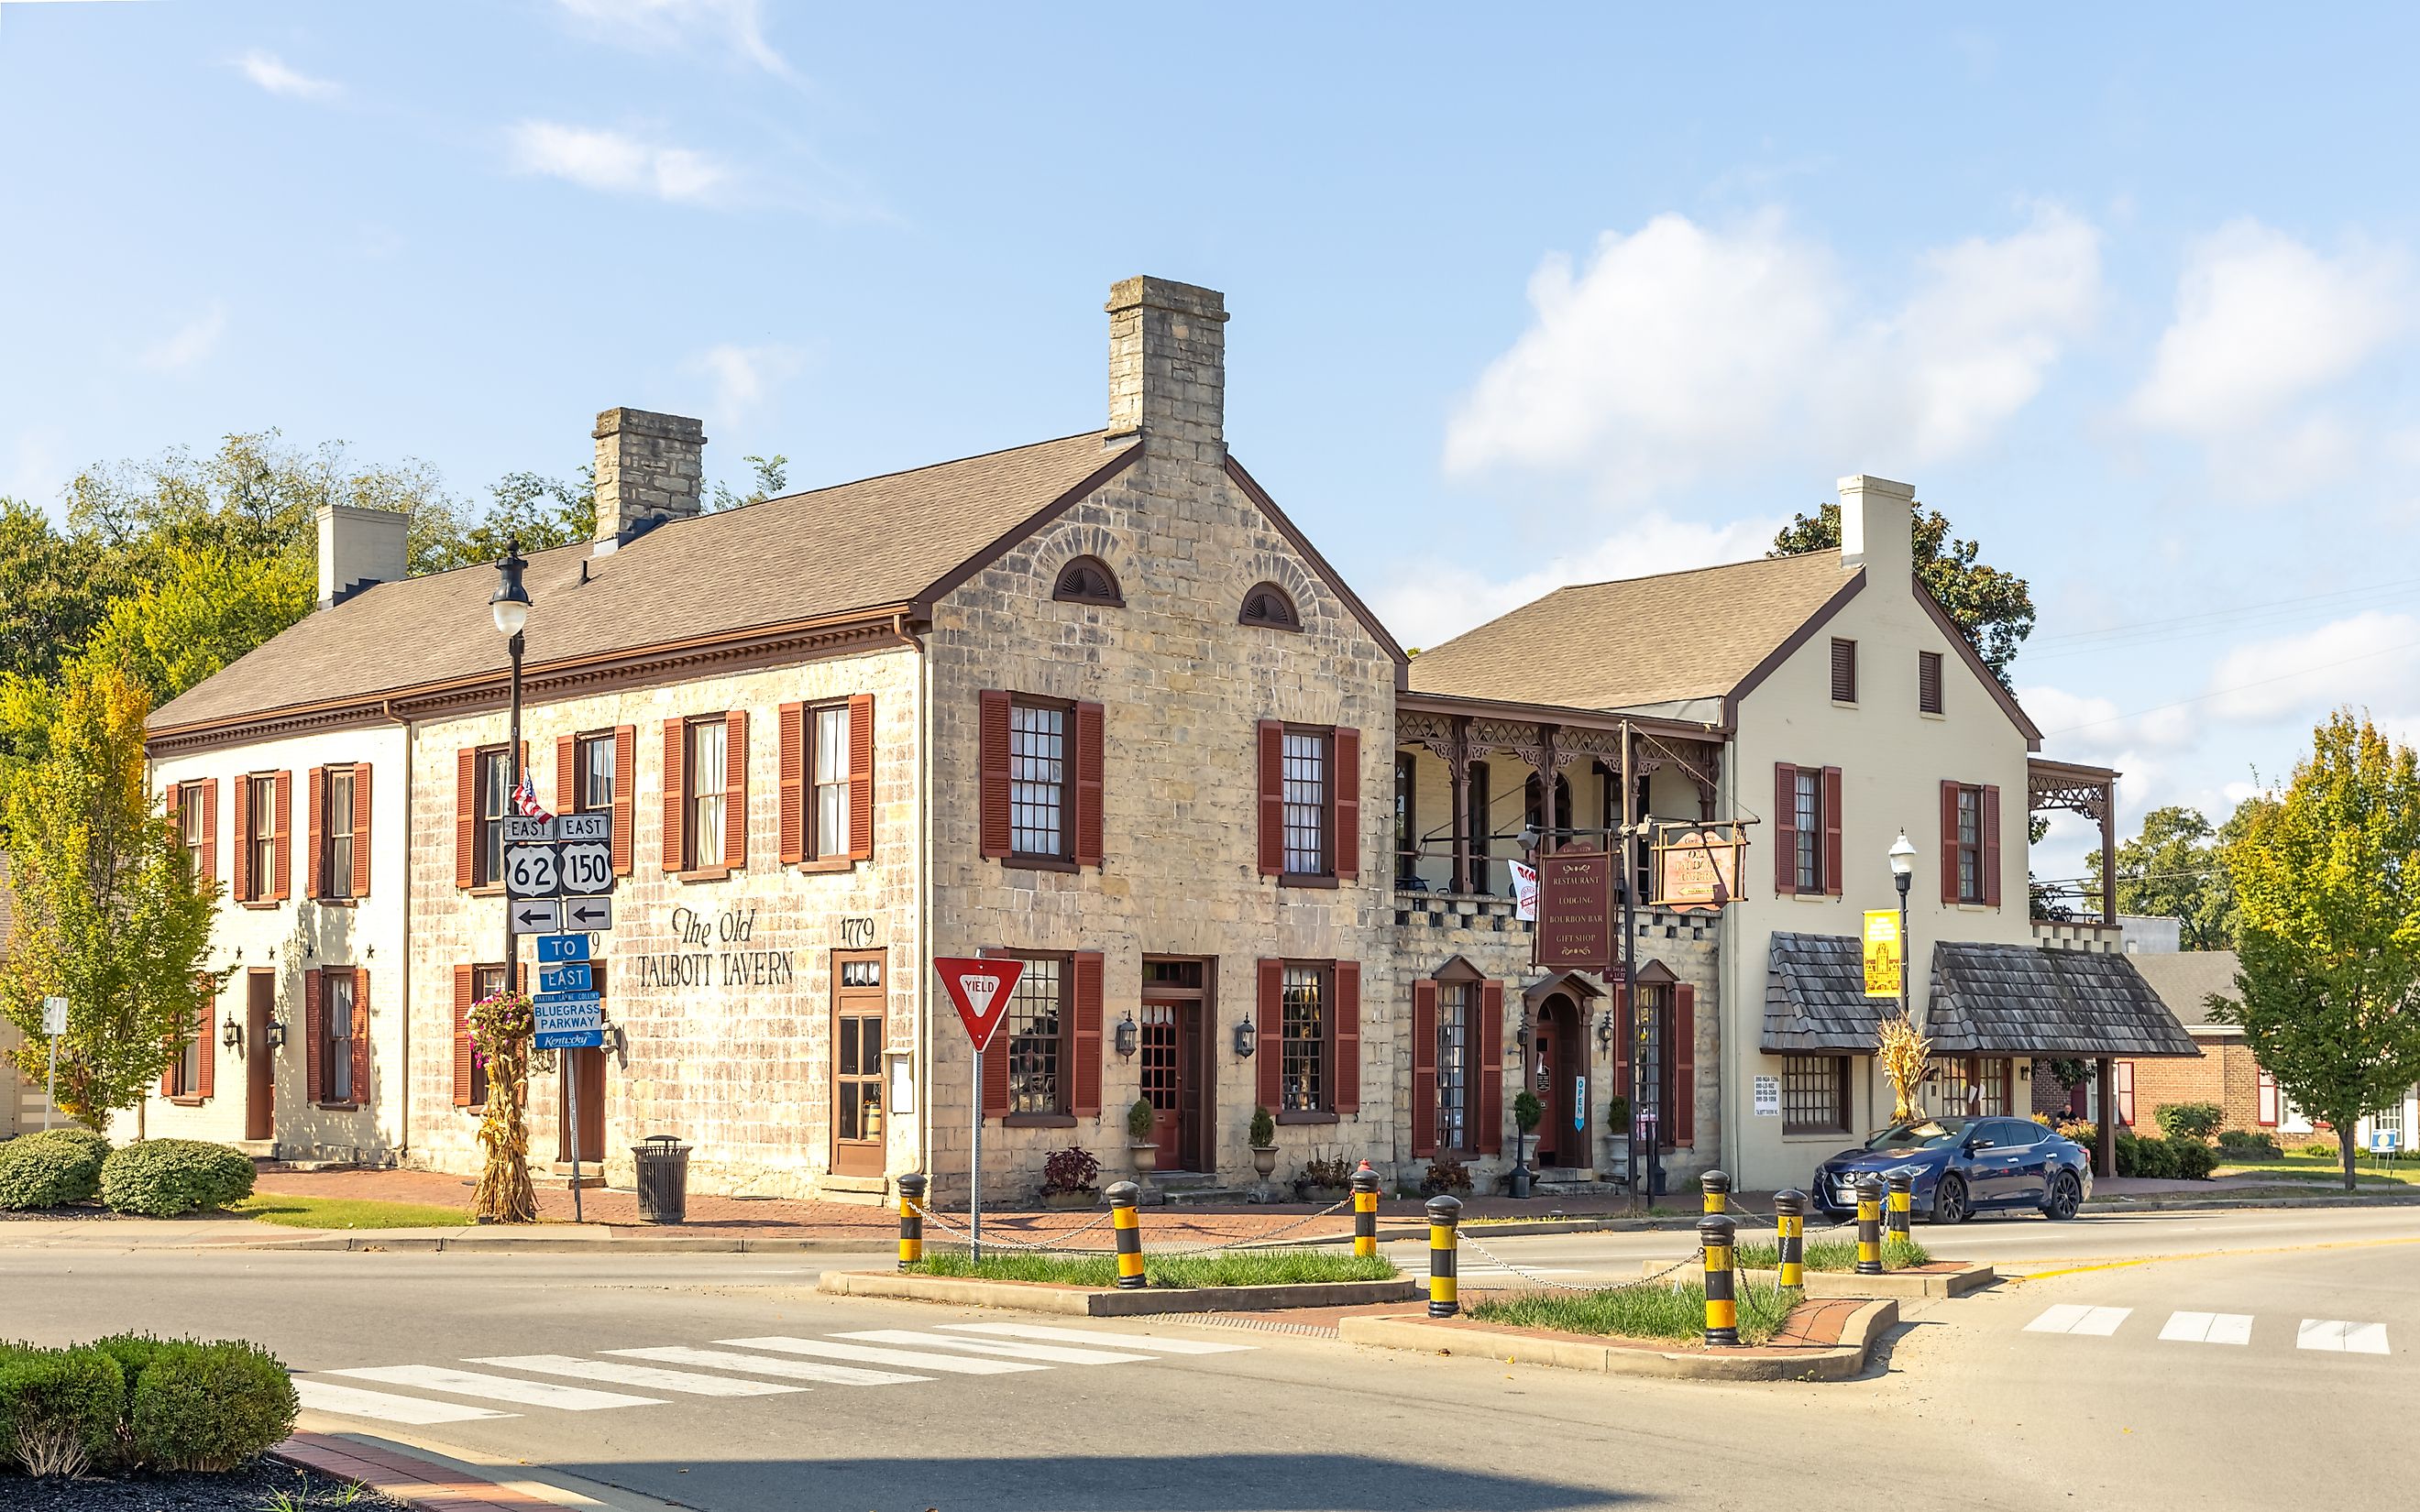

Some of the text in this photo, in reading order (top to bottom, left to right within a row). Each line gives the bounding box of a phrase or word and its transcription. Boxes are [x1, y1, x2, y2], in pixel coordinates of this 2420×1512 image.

[512, 821, 545, 837] EAST
[566, 820, 601, 835] EAST
[514, 857, 551, 886] 62
[570, 854, 606, 883] 150
[1553, 877, 1600, 885] RESTAURANT
[1549, 915, 1603, 924] BOURBON BAR
[672, 907, 756, 948] The Old
[840, 917, 874, 948] 1779
[1556, 934, 1596, 943] GIFT SHOP
[551, 940, 576, 956] TO
[638, 951, 794, 988] TALBOTT TAVERN
[548, 970, 584, 986] EAST
[965, 980, 995, 992] YIELD
[534, 994, 555, 1003] MARTHA
[578, 992, 600, 1001] COLLINS
[534, 1003, 600, 1017] BLUEGRASS
[541, 1016, 595, 1029] PARKWAY
[544, 1034, 588, 1047] Kentucky
